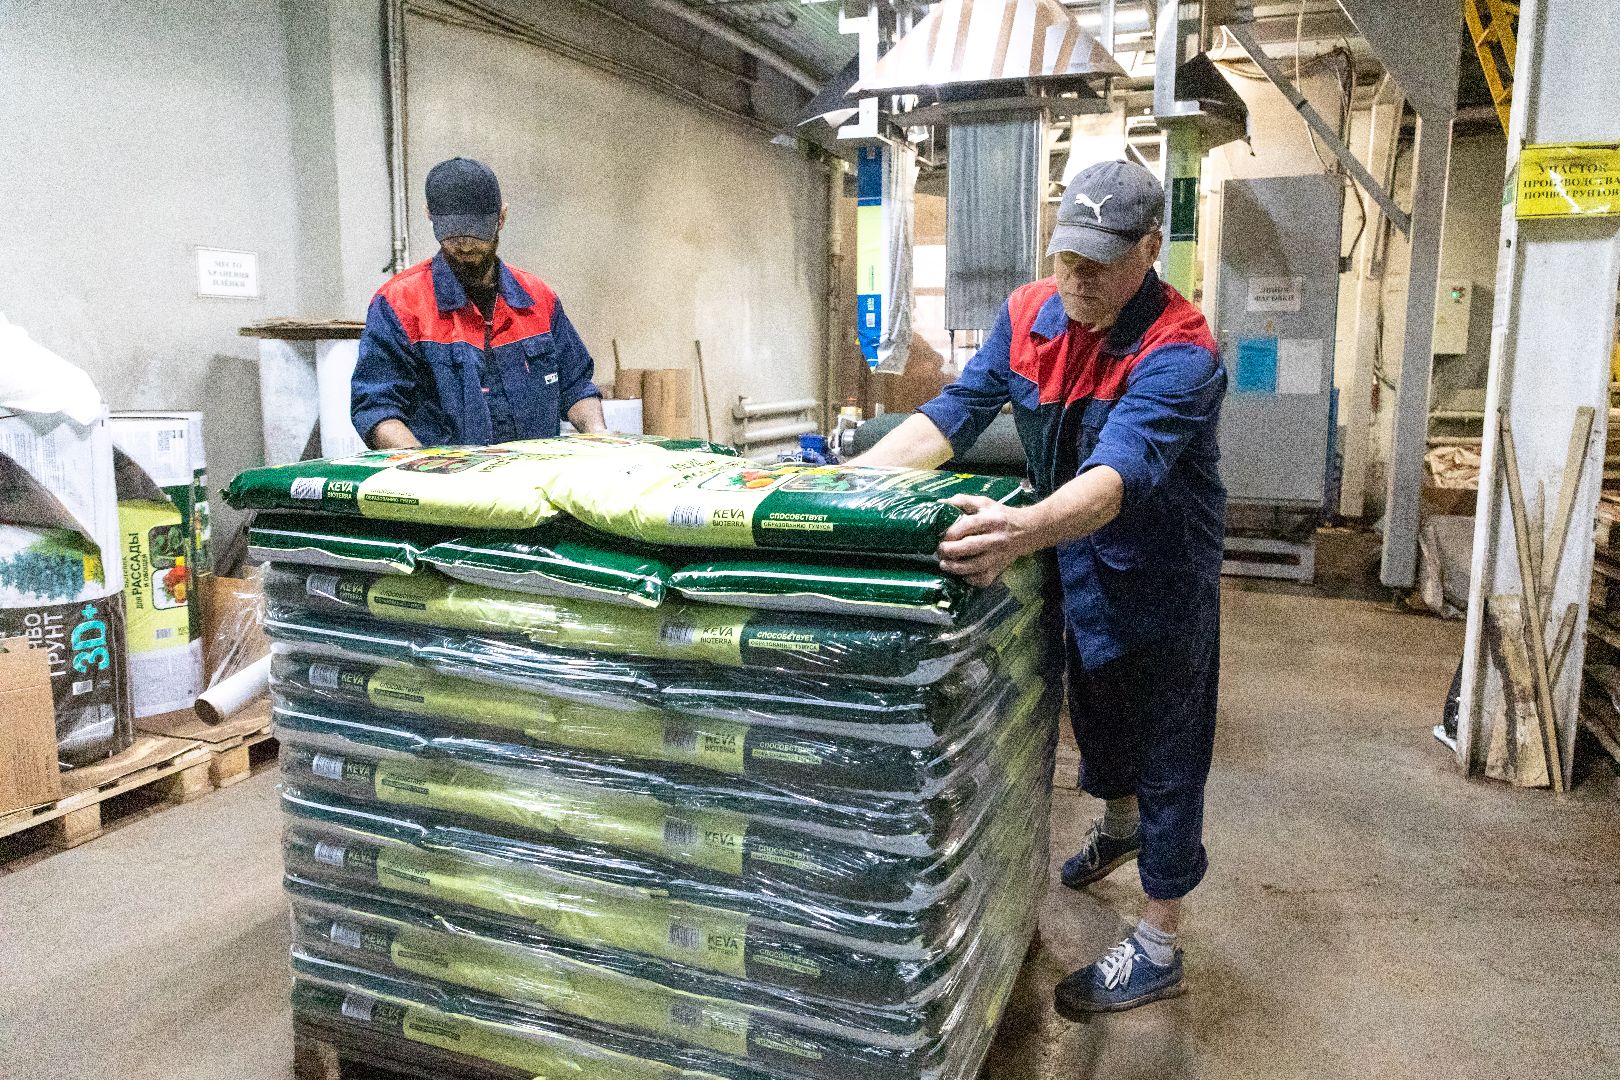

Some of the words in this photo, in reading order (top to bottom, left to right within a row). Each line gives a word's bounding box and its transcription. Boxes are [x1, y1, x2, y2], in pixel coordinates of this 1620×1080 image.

[1523, 176, 1620, 188] ПРОИВОДСВА
[328, 481, 353, 492] KEVA
[713, 508, 745, 519] KEVA
[769, 512, 828, 522] СПОСОБСТВУЕТ
[712, 520, 745, 528] BIOTERRA
[128, 533, 142, 596] РАССАДЫ
[702, 627, 733, 637] KEVA
[757, 631, 814, 641] СПОСОБСТВУЕТ
[701, 637, 733, 645] BIOTERRA
[341, 672, 364, 685] KEVA
[346, 763, 371, 776] KEVA
[705, 831, 734, 846] KEVA
[707, 934, 738, 950] KEVA
